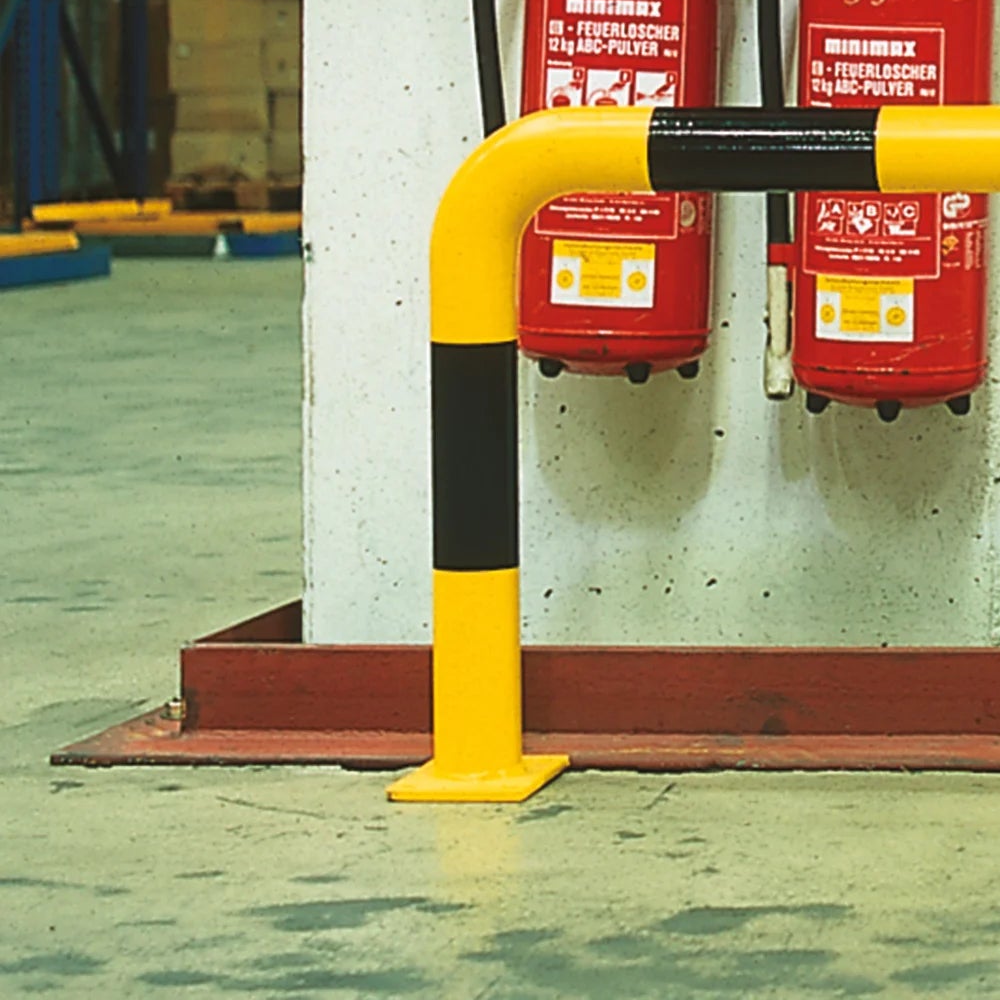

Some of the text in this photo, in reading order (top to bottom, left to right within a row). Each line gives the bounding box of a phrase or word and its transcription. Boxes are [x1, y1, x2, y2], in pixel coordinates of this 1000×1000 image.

[831, 203, 916, 218] A B C
